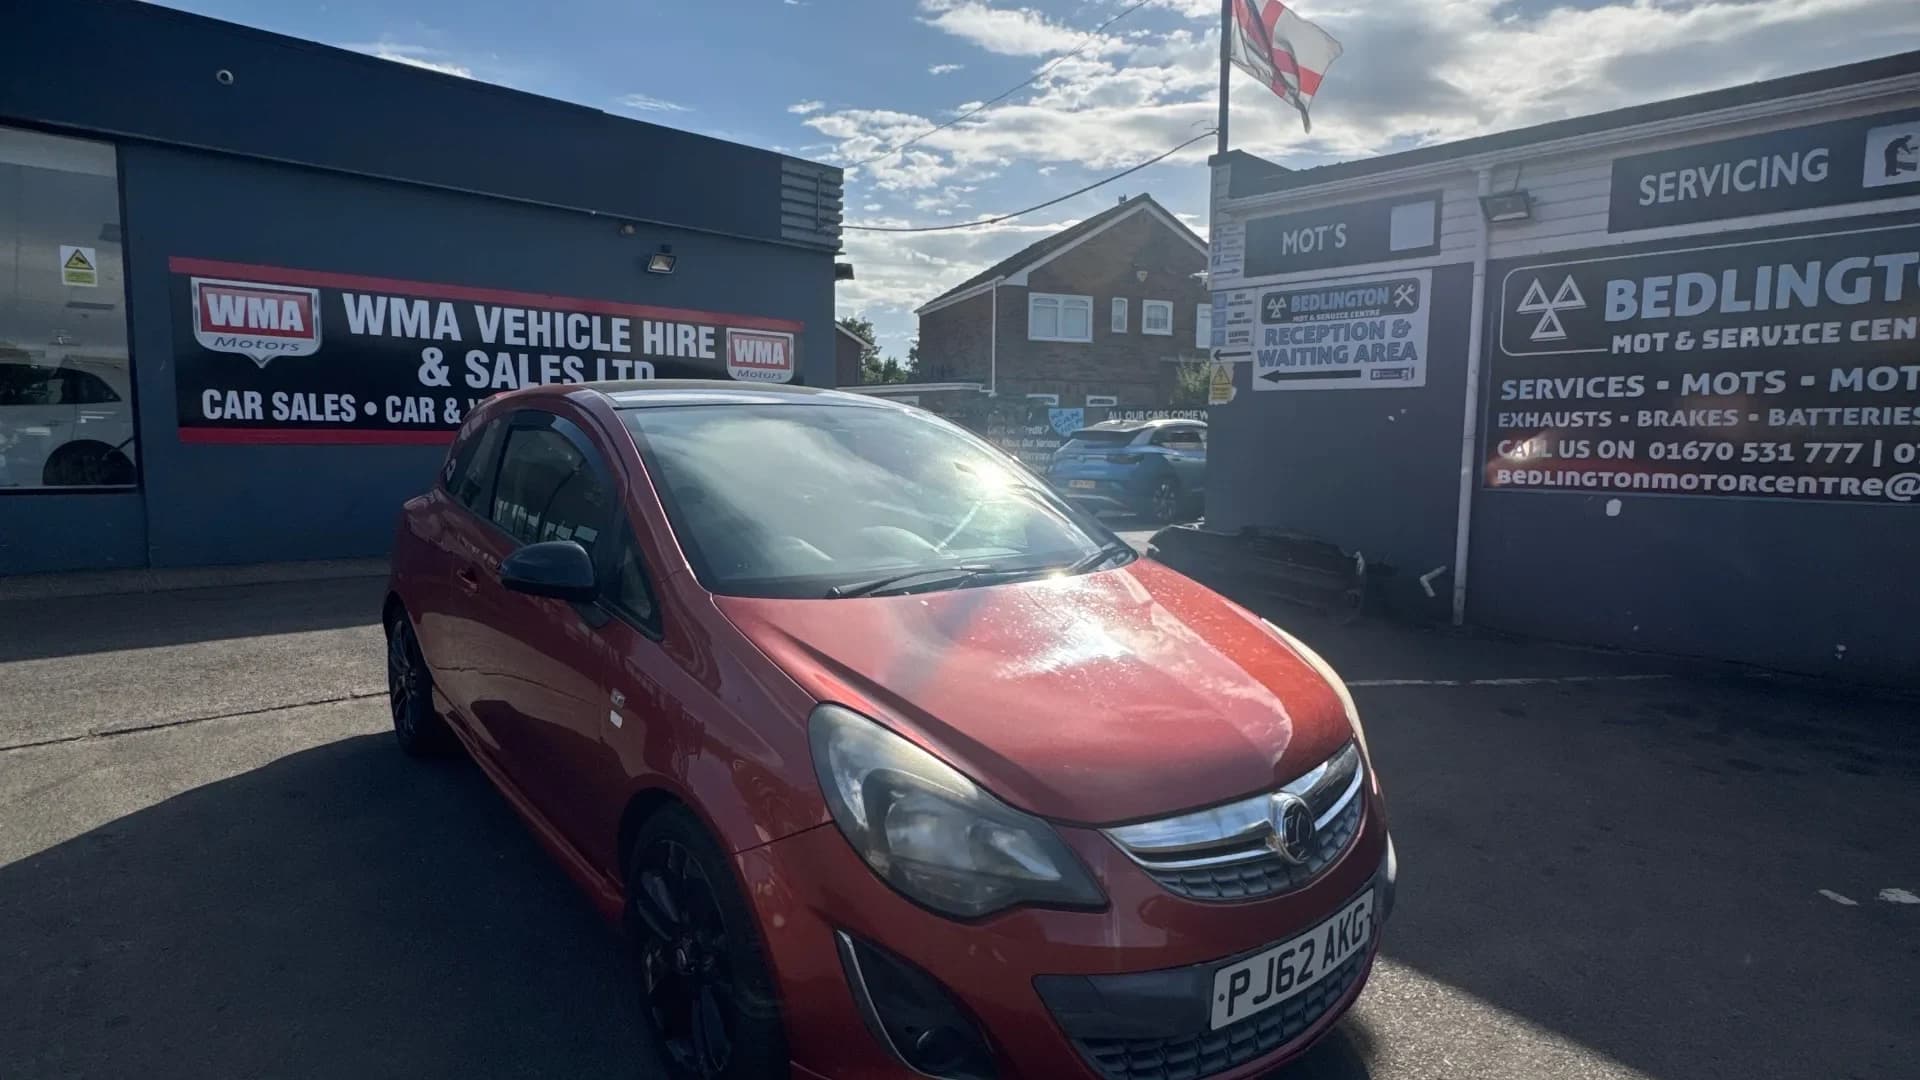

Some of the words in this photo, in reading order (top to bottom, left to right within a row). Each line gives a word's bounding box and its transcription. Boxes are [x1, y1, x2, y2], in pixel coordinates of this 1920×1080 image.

[1639, 147, 1830, 207] SERVICING
[1282, 223, 1347, 255] MOT'S
[1291, 287, 1389, 313] BEDLINGTON
[1604, 252, 1920, 322] BEDLINGT
[206, 293, 304, 332] WMA
[343, 293, 462, 341] WMA
[474, 304, 631, 353] VEHICLE
[643, 320, 715, 359] HIRE
[213, 336, 299, 352] Motors
[1265, 320, 1385, 346] RECEPTION
[1392, 319, 1412, 339] &
[1612, 333, 1670, 354] MOT
[1675, 331, 1696, 351] &
[1702, 322, 1841, 350] SERVICE
[418, 347, 451, 386] &
[465, 349, 584, 388] SALES
[597, 358, 655, 380] LTD
[734, 339, 785, 366] WMA
[1257, 344, 1349, 367] WAITING
[1353, 341, 1418, 364] AREA
[737, 369, 783, 381] Motors
[1502, 376, 1645, 401] SERVICES
[1680, 371, 1786, 395] MOTS
[202, 389, 264, 420] CAR
[272, 391, 356, 422] SALES
[386, 395, 435, 424] CAR
[443, 397, 462, 424] &
[1125, 411, 1144, 420] OUR
[1171, 410, 1198, 420] COME
[1497, 411, 1612, 428] EXHAUSTS
[1637, 409, 1739, 427] BRAKES
[1497, 440, 1552, 459] CALL
[1559, 440, 1591, 458] US
[1598, 440, 1635, 458] ON
[1648, 441, 1734, 460] 01670
[1741, 442, 1795, 462] 531
[1804, 443, 1864, 463] 777
[1894, 442, 1920, 463] 0
[1228, 940, 1315, 1017] PJ62
[1322, 902, 1365, 970] AKG
